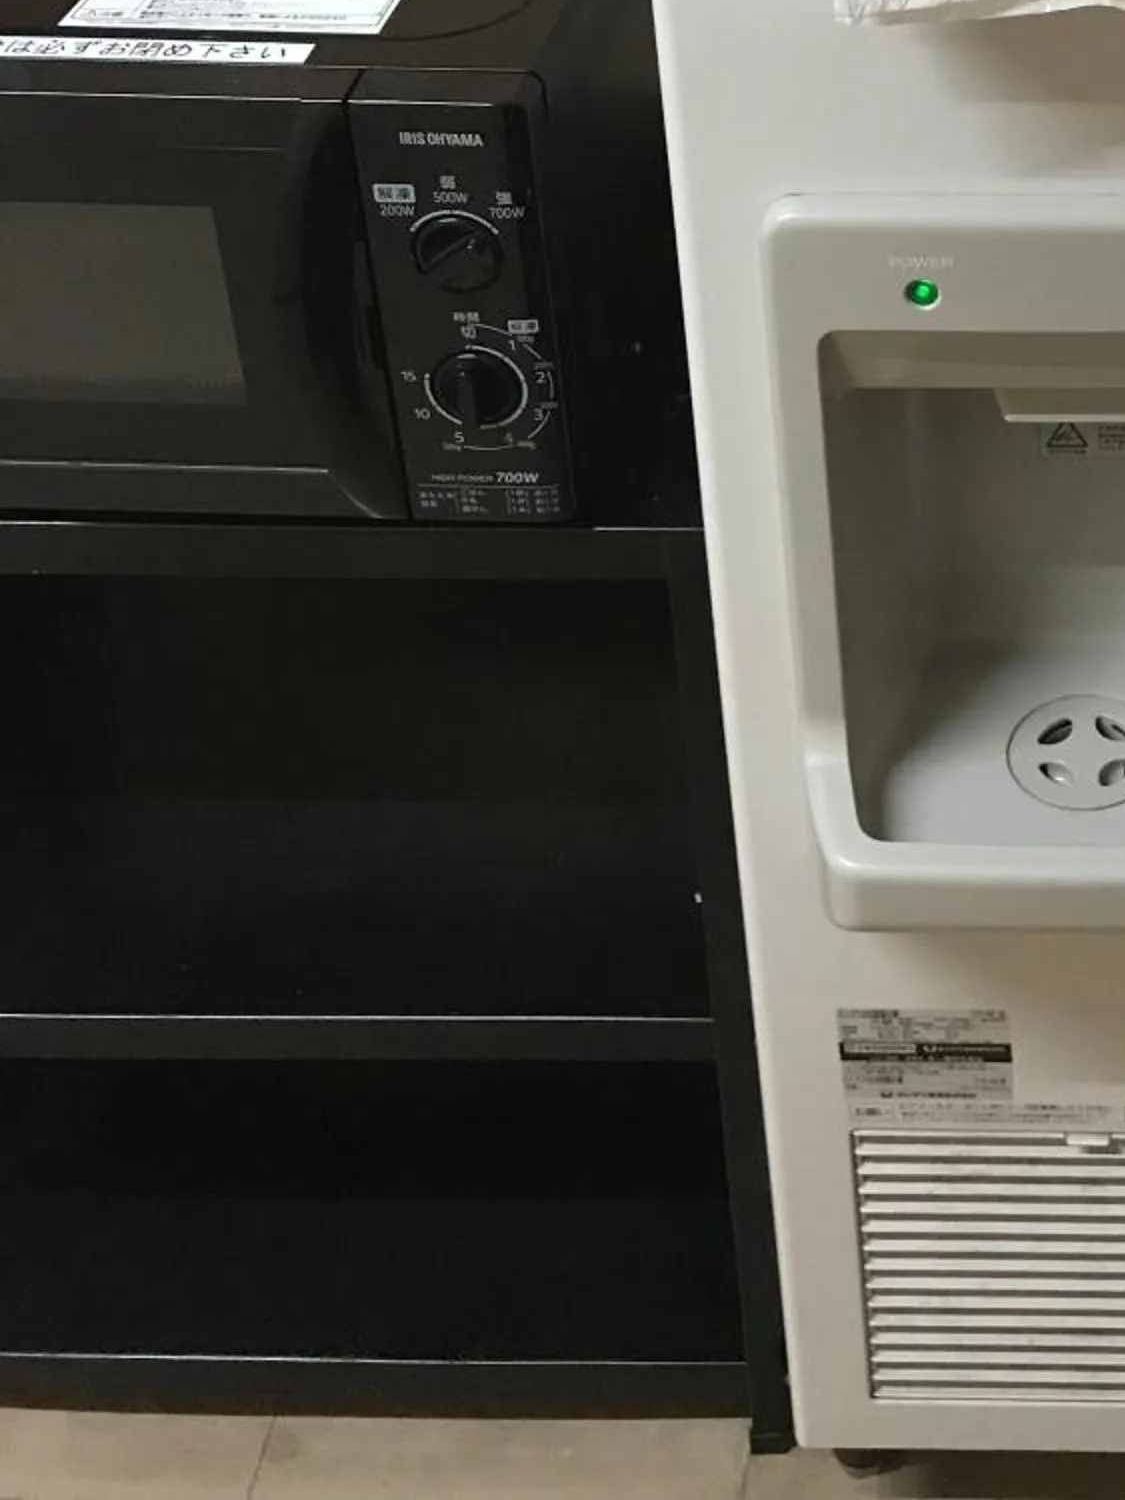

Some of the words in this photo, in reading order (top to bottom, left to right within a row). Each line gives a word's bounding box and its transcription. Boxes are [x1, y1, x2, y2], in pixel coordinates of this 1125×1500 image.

[0, 37, 287, 60] は必ずお閉め下さい
[399, 131, 426, 145] IRIS
[427, 132, 484, 147] OHYAMA
[432, 192, 468, 204] 500W
[379, 204, 415, 217] 200W
[489, 207, 525, 219] 700W
[889, 255, 953, 268] POWER
[508, 339, 516, 351] 1
[400, 371, 417, 382] 15
[535, 372, 546, 383] 2
[414, 409, 431, 420] 10
[534, 410, 543, 421] 3
[454, 431, 465, 444] 5
[495, 472, 540, 483] 700W
